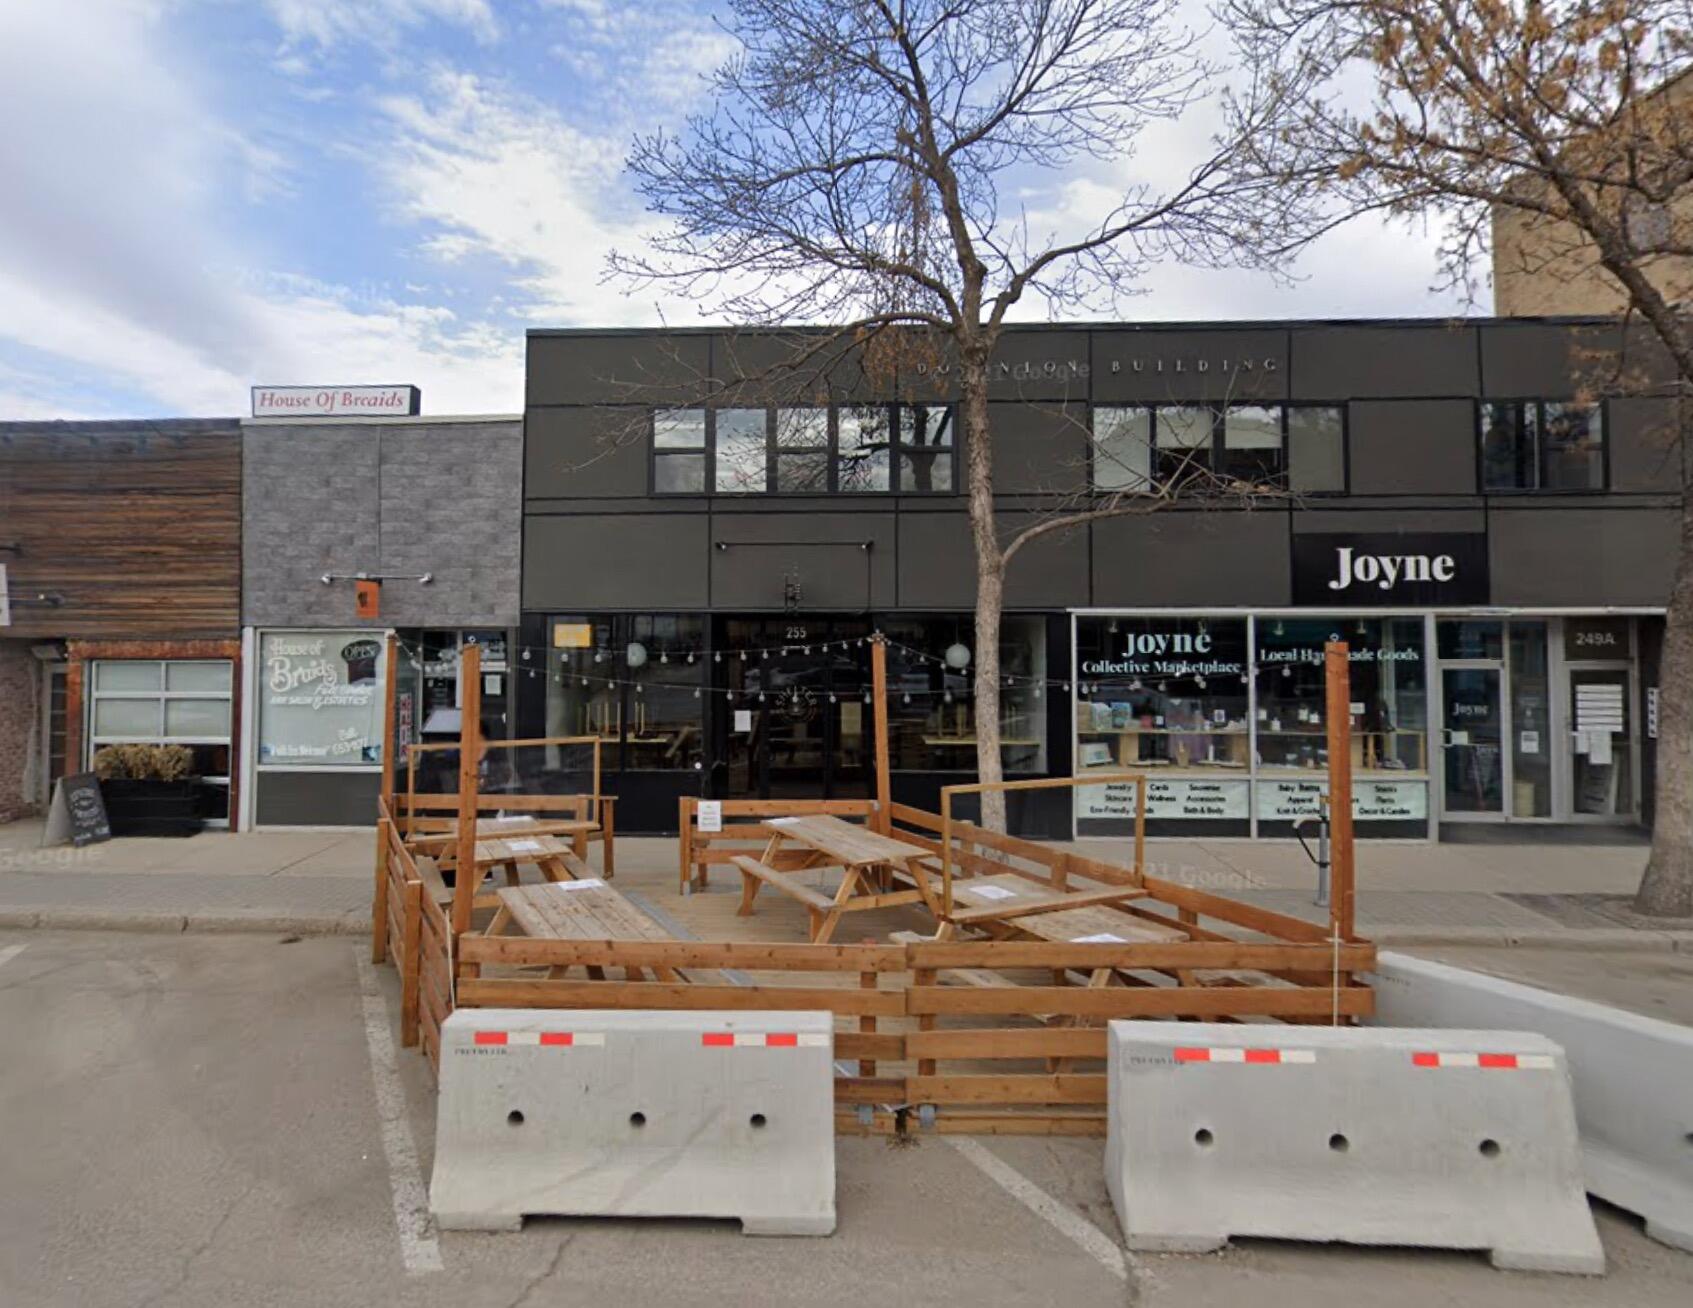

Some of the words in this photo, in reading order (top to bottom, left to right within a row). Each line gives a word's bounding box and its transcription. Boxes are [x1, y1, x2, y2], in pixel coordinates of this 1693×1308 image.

[1112, 358, 1276, 372] BUILDING
[259, 392, 311, 407] House
[317, 391, 339, 412] Of
[1328, 547, 1455, 590] Joyne
[786, 627, 807, 639] 255
[1575, 632, 1616, 645] 249A
[1260, 648, 1297, 661] Local
[1377, 648, 1419, 661] Goods
[1082, 660, 1150, 673] Collective
[1154, 660, 1241, 675] Marketplace
[1453, 703, 1489, 716] Joyne
